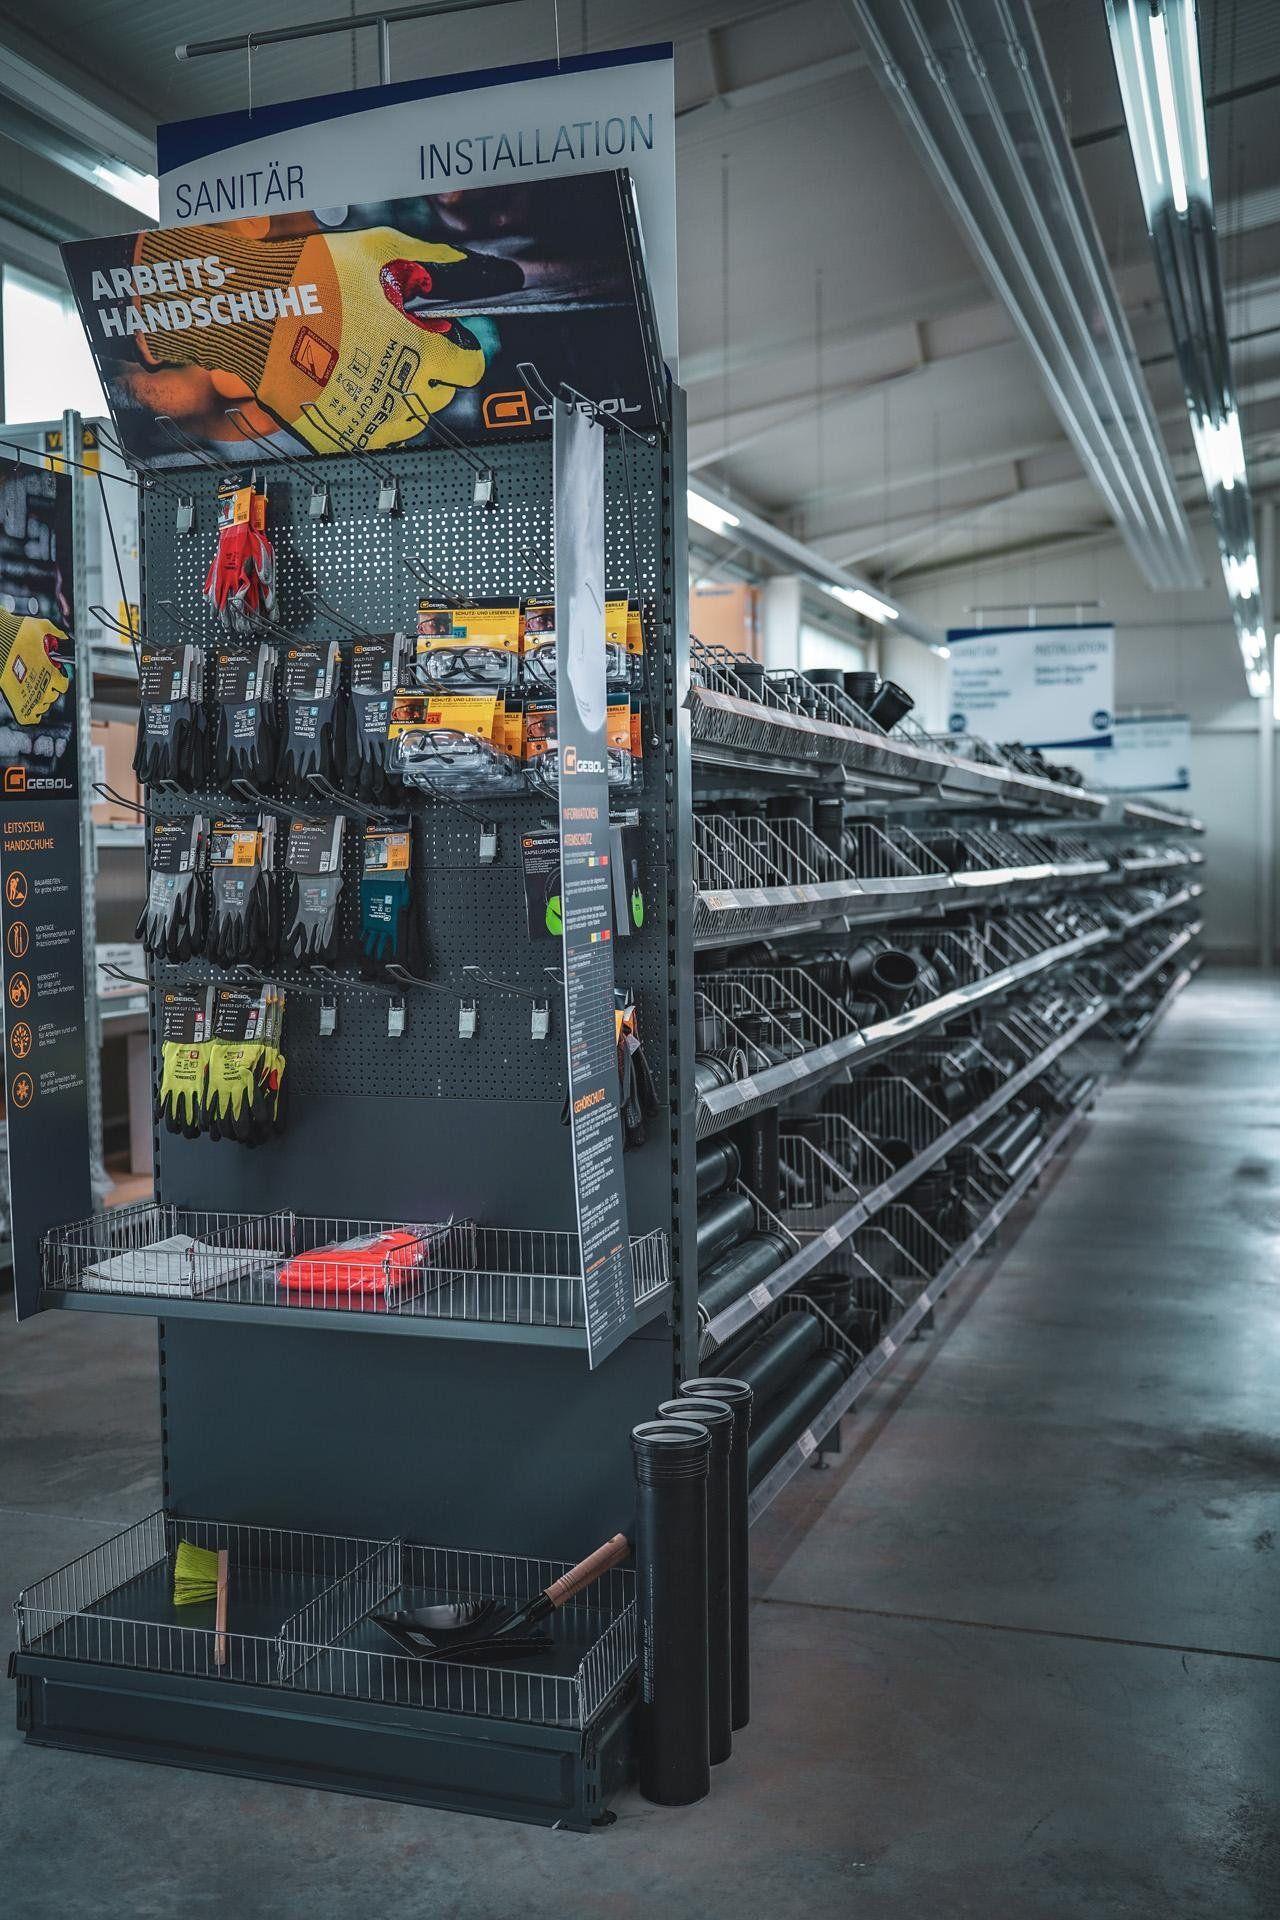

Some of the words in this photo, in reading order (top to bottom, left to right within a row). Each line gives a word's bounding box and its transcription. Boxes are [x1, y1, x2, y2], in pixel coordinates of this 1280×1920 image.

[176, 160, 304, 219] SANITÄR
[419, 113, 654, 180] INSTALLATION
[92, 256, 236, 301] ARBEITS-
[98, 284, 323, 338] HANDSCHUHE
[370, 338, 398, 394] MASTER
[359, 396, 373, 419] CUT
[534, 398, 642, 421] GBOL
[338, 424, 355, 447] PLU
[577, 760, 605, 773] GEBOL
[27, 778, 73, 790] GEBOL
[3, 821, 45, 834] LEITSYSTEM
[4, 838, 55, 851] HANDSCHUHE
[574, 1088, 605, 1114] GEHÖRSCHUTZ
